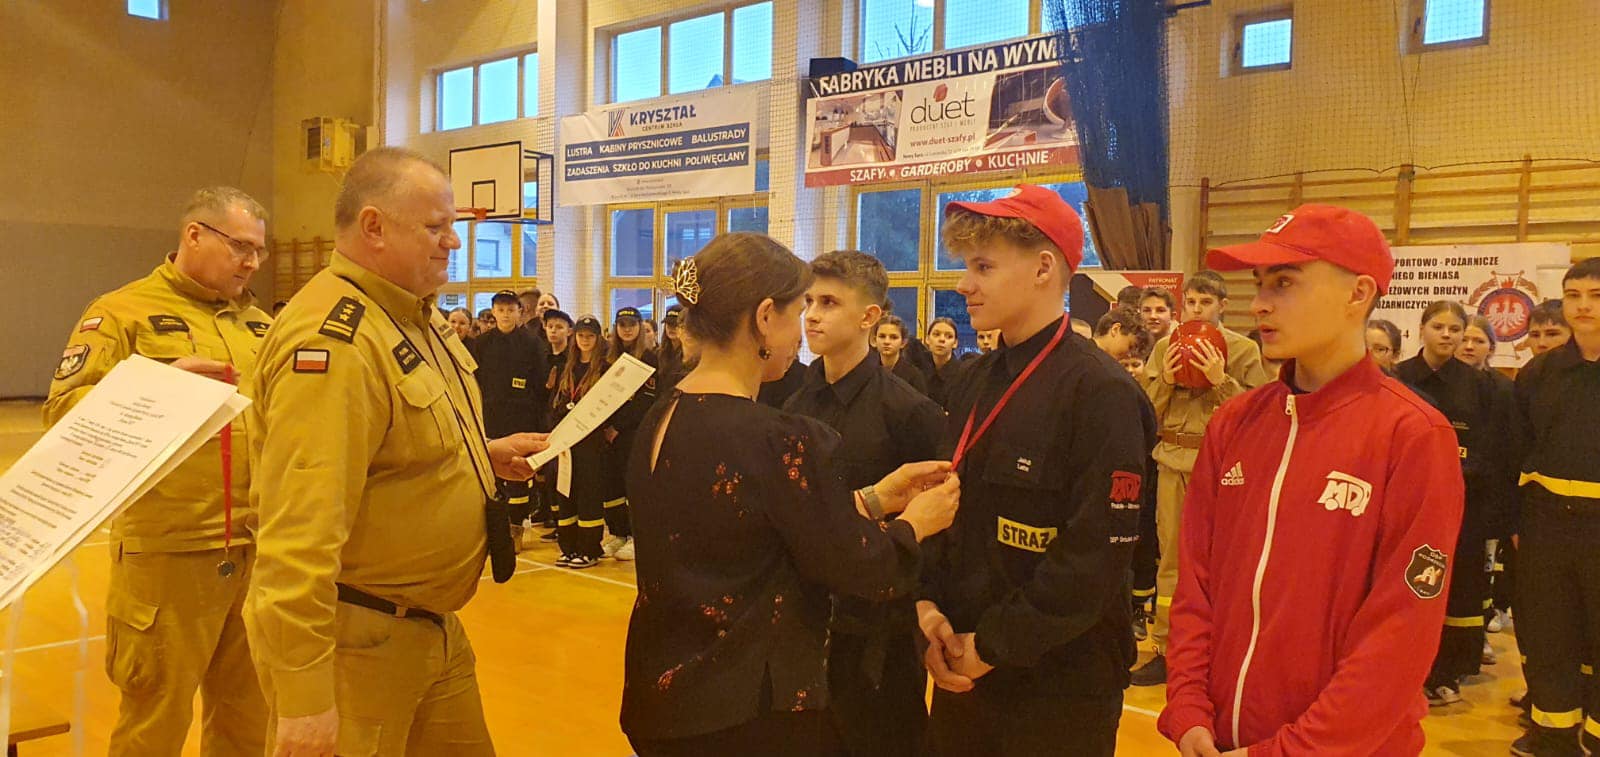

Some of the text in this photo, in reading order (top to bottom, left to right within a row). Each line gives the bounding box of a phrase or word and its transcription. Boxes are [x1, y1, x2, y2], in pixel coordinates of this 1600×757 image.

[819, 36, 1066, 95] FABRYKA MEBLI NA WYM
[630, 104, 696, 126] KRYSZTAŁ
[910, 91, 975, 124] duet
[567, 128, 746, 157] LUSTRA KABINY PRYSZNICOWE BALUSTRADY
[910, 133, 976, 147] www.duet-szafy.pl
[567, 151, 745, 177] ZADASZENIA SZKŁO DO KUCHNI POLIWĘGLANY
[850, 168, 884, 182] SZAFY
[900, 159, 972, 177] GARDEROBY
[988, 150, 1049, 169] KUCHNIE
[1395, 258, 1438, 267] PORTOWO
[1445, 256, 1499, 266] POŻARNICZE
[1418, 271, 1460, 280] BIENIASA
[1389, 285, 1468, 295] EŻOWYCH DRUŻYN
